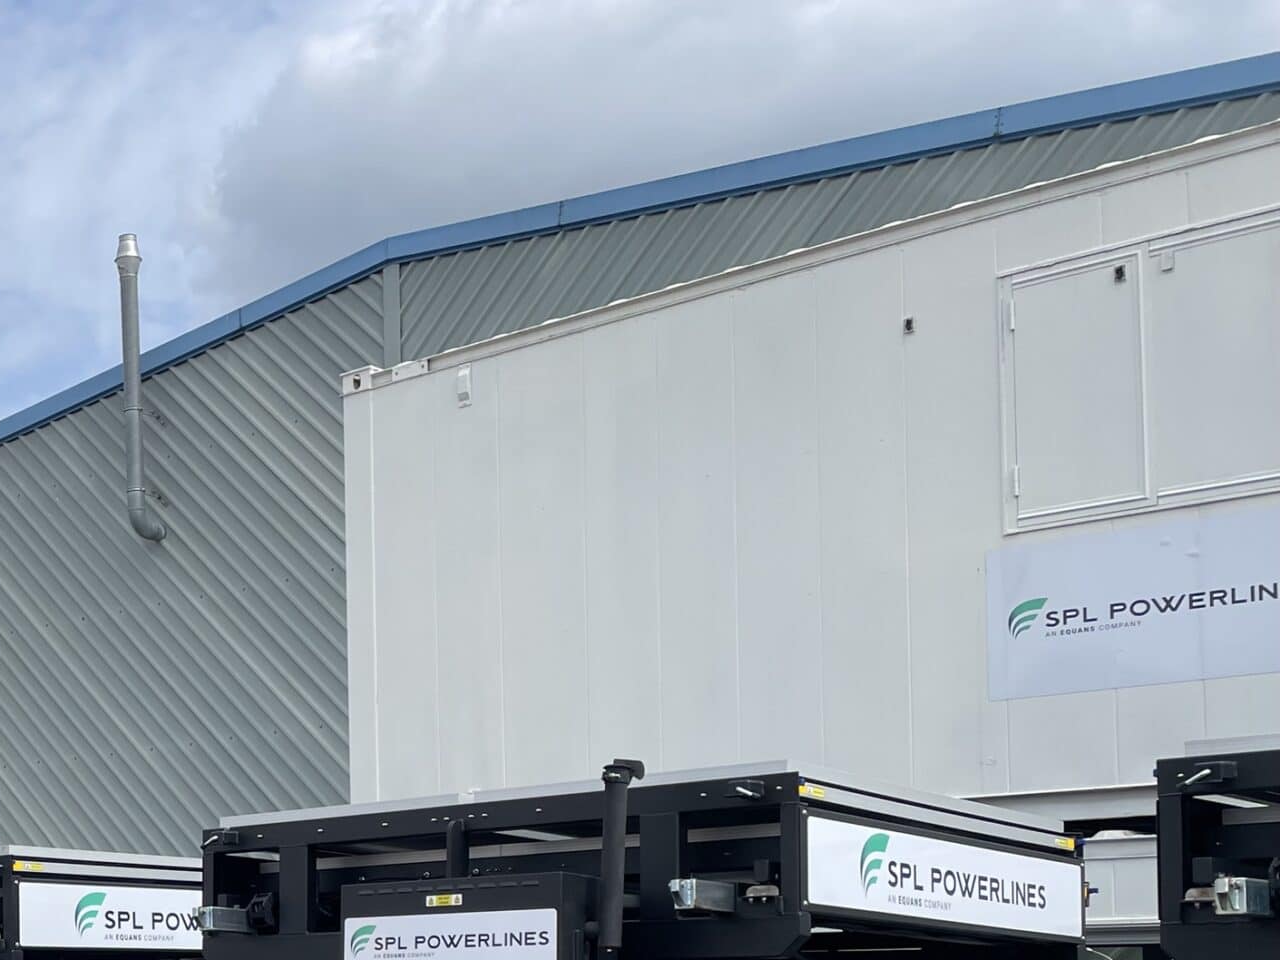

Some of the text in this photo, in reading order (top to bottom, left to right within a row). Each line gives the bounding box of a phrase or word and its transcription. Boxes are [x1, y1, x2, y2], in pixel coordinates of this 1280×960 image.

[1045, 582, 1279, 628] SPL POWERLIN
[1060, 626, 1096, 636] EQUANS
[1098, 620, 1142, 631] COMPANY
[888, 860, 1047, 909] SPL POWERLINES
[898, 896, 923, 907] EQUANS
[924, 899, 952, 910] COMPANY
[104, 910, 144, 930] SPL
[374, 931, 550, 951] SPL POWERLINES
